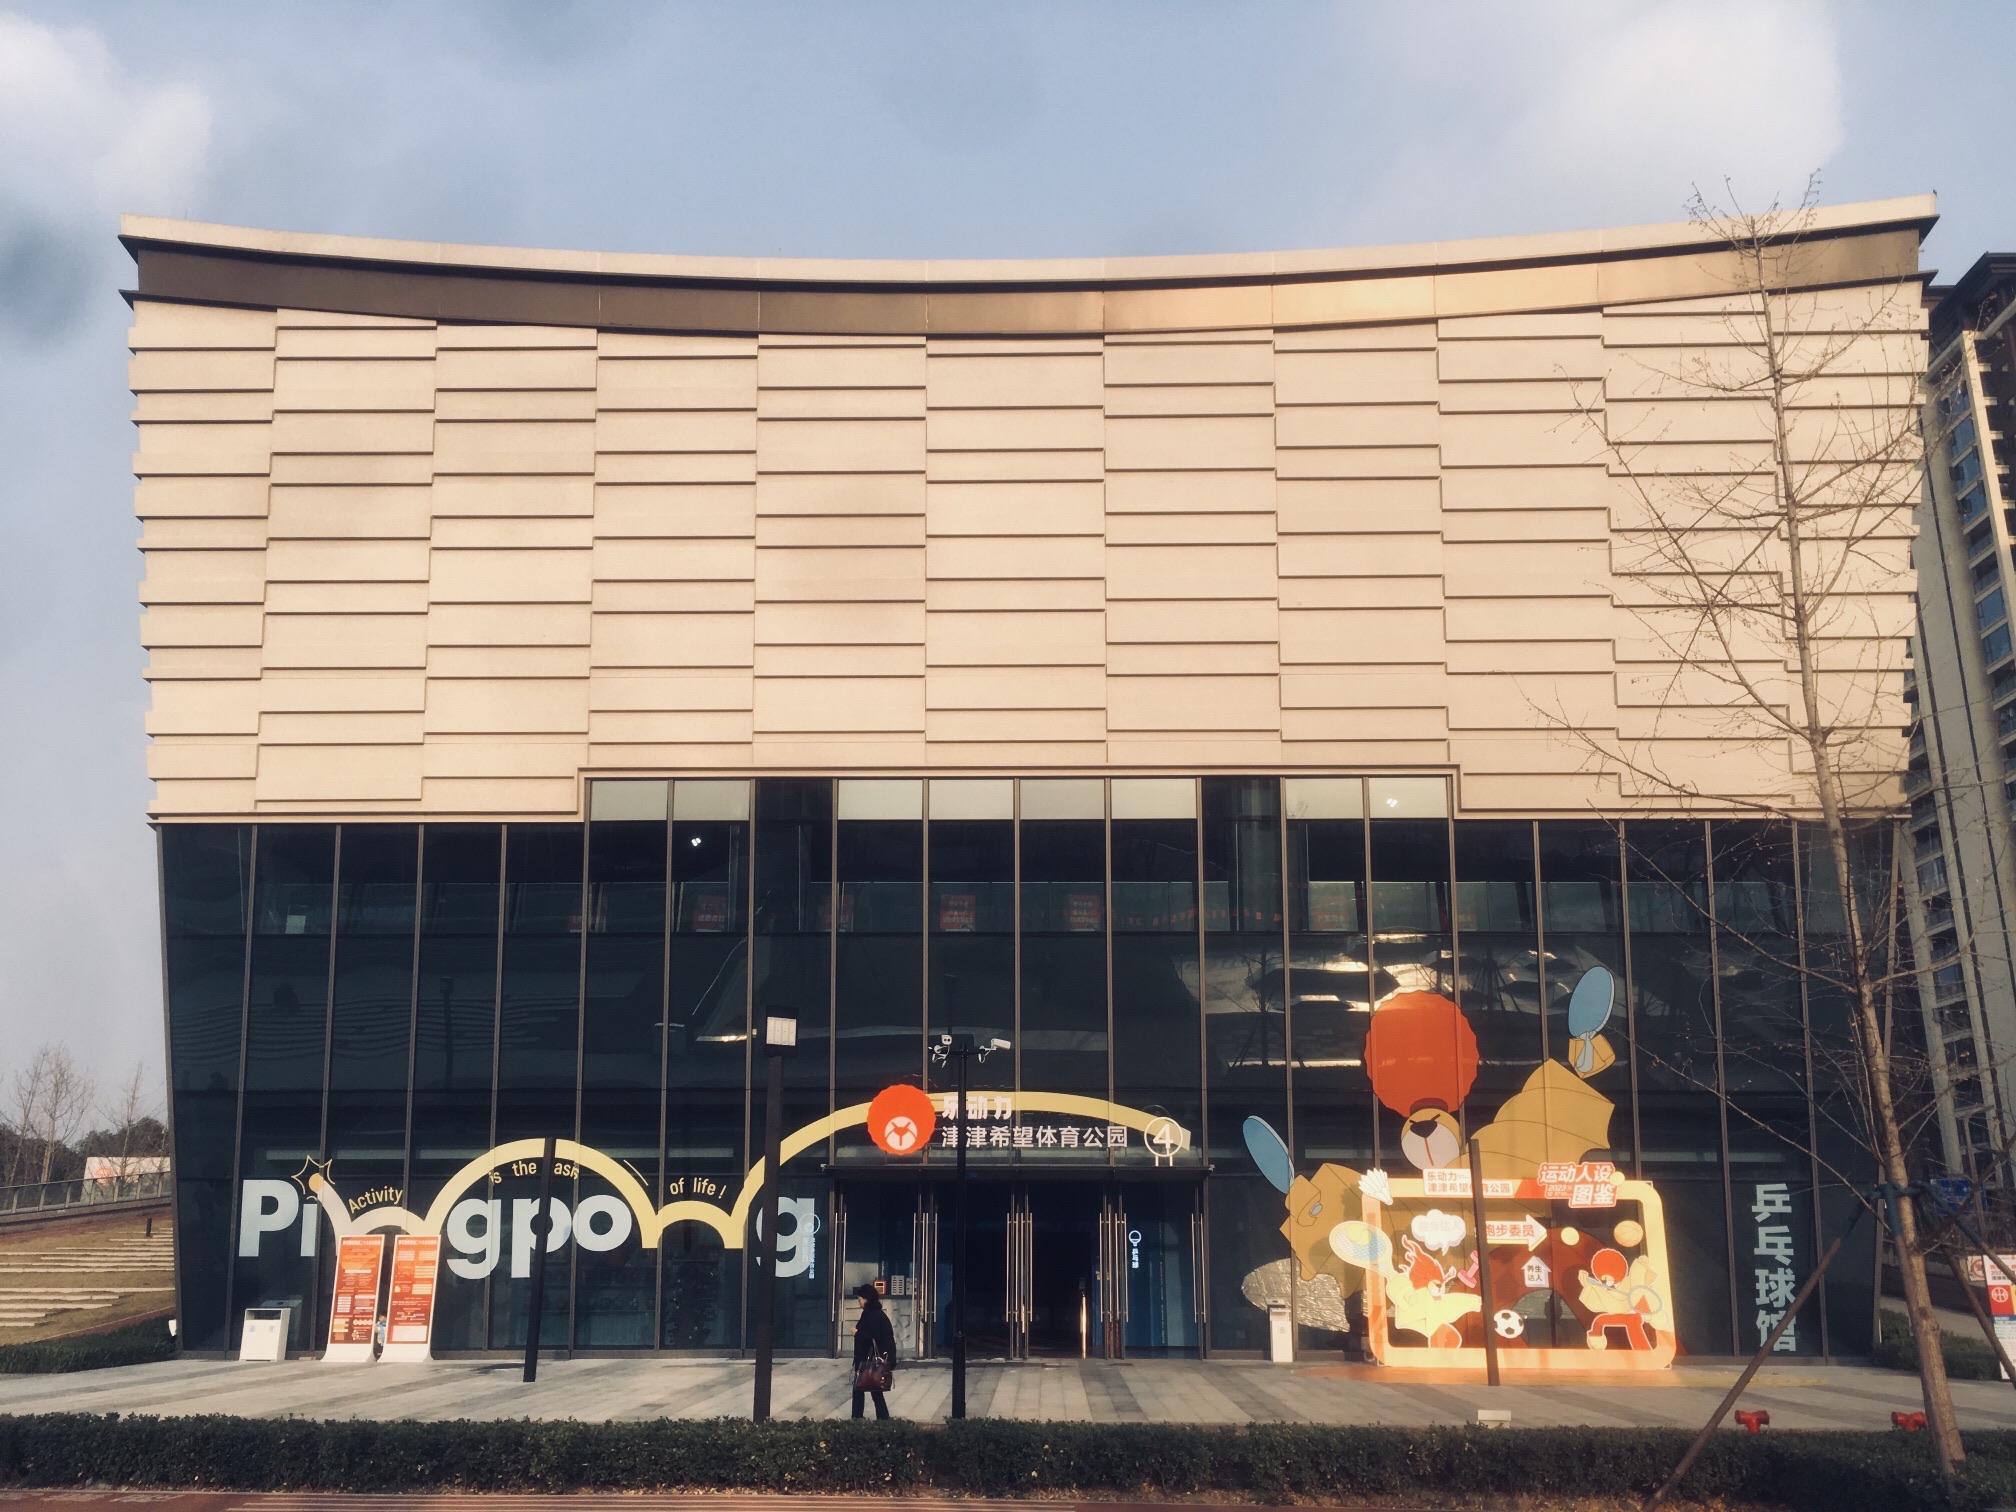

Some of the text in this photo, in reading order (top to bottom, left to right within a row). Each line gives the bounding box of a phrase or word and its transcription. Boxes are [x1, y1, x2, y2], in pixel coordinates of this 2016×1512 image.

[942, 1095, 1012, 1120] 乐动力
[942, 1125, 1128, 1148] 津津希望体育公园
[1540, 1164, 1612, 1183] 运动人设
[348, 1160, 727, 1213] Activity is the asis of life!
[1428, 1183, 1510, 1193] 津津希望育公园
[1572, 1183, 1615, 1205] 图鉴
[1527, 1274, 1543, 1282] 达人
[1751, 1183, 1797, 1352] 乒乓球馆
